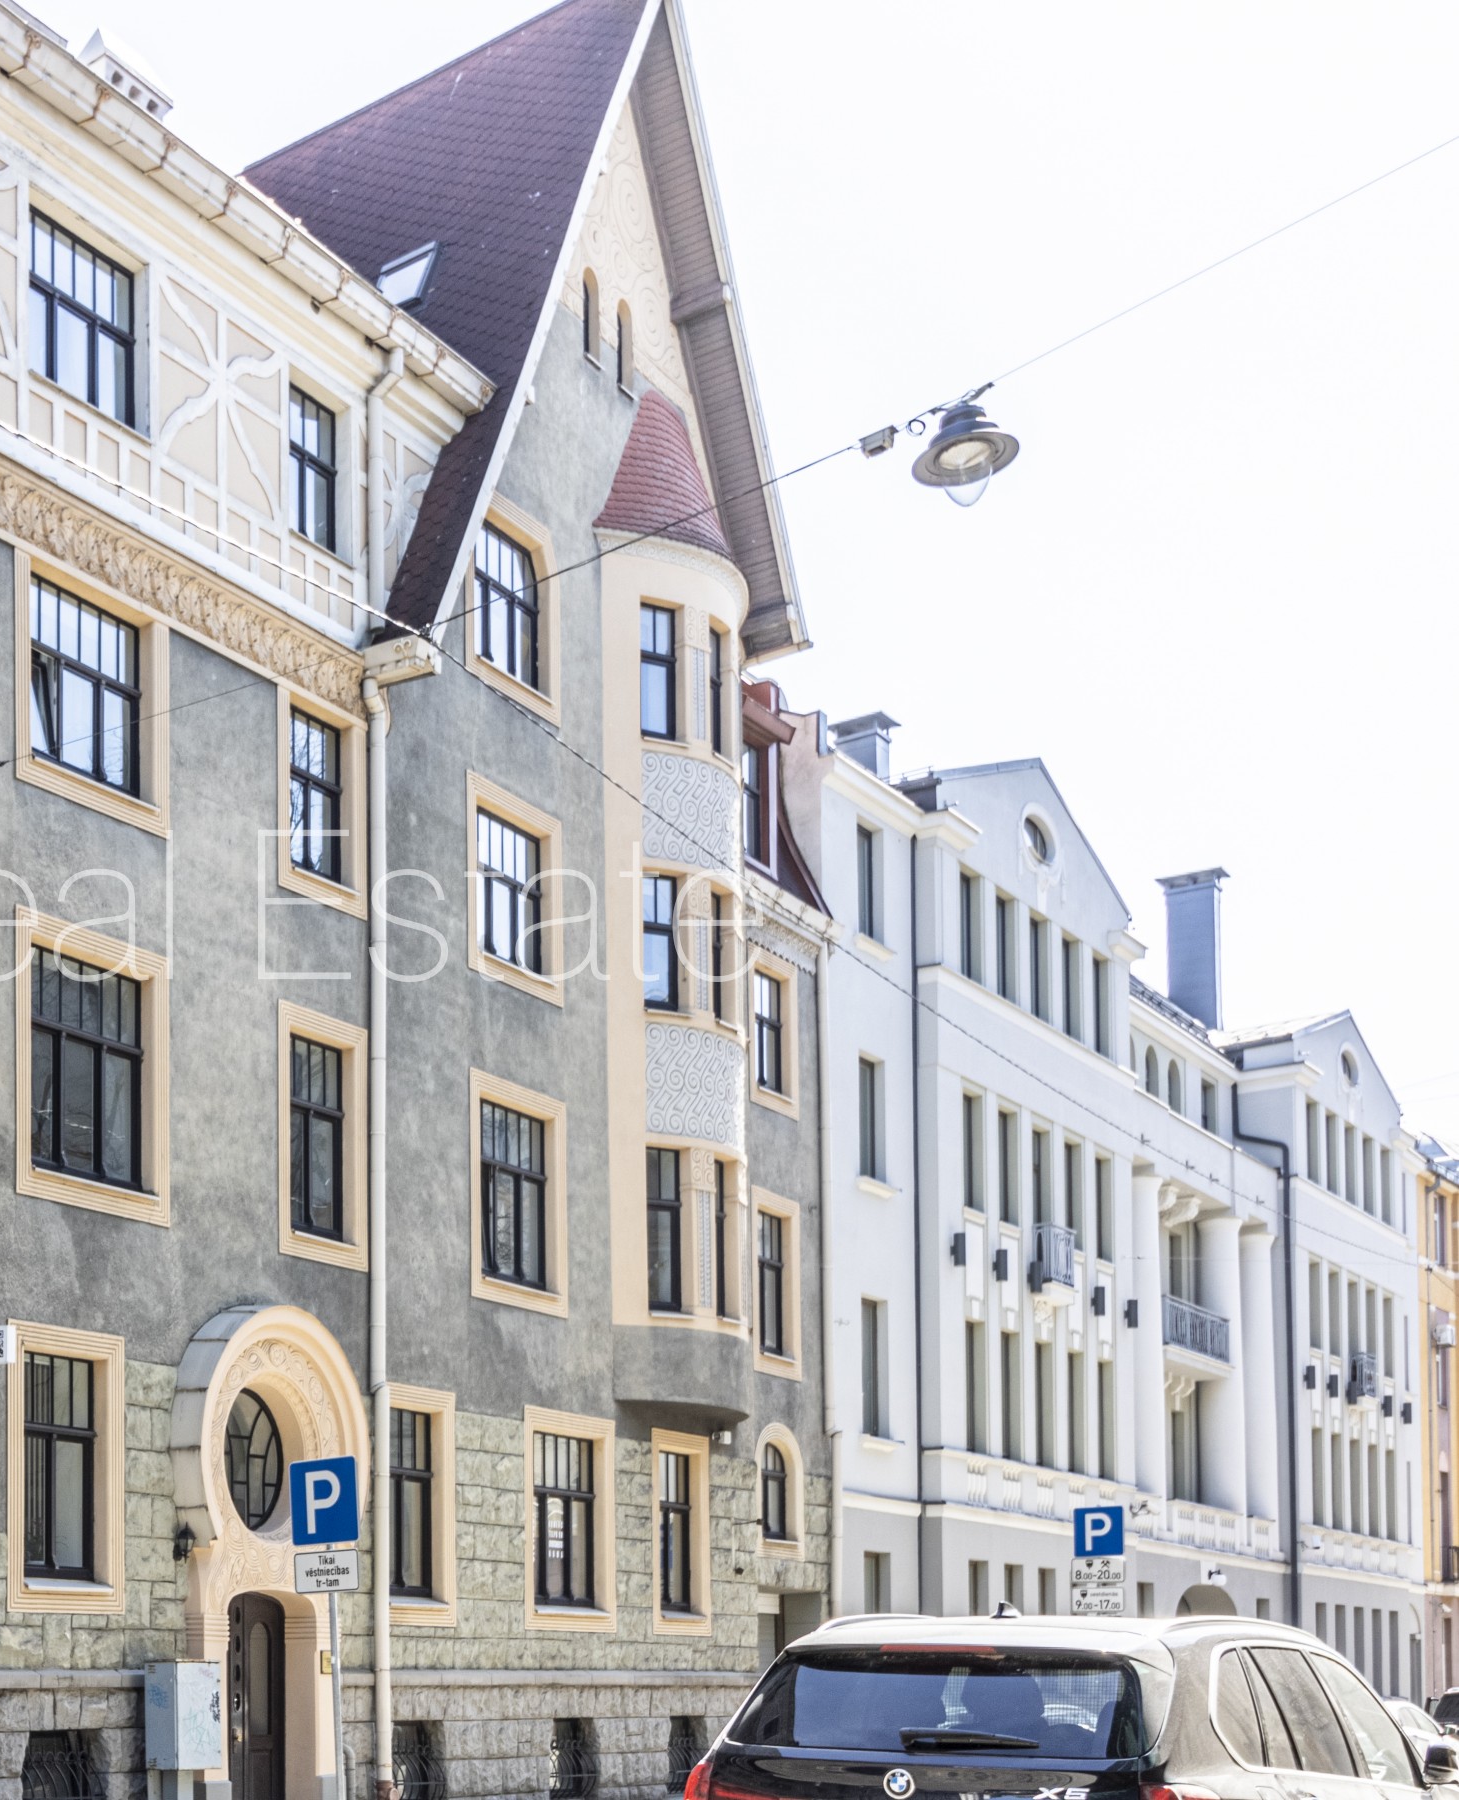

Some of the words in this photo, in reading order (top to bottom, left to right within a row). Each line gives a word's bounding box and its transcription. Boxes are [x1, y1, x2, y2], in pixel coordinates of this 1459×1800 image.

[304, 1469, 341, 1535] P
[1084, 1511, 1112, 1552] P
[318, 1555, 336, 1565] Tikai
[305, 1566, 350, 1578] vēstniecības
[1075, 1569, 1121, 1581] 8.00-20.00
[316, 1578, 340, 1588] tr-tam
[1075, 1599, 1121, 1610] 9.00-17.00
[1032, 1786, 1091, 1800] X5
